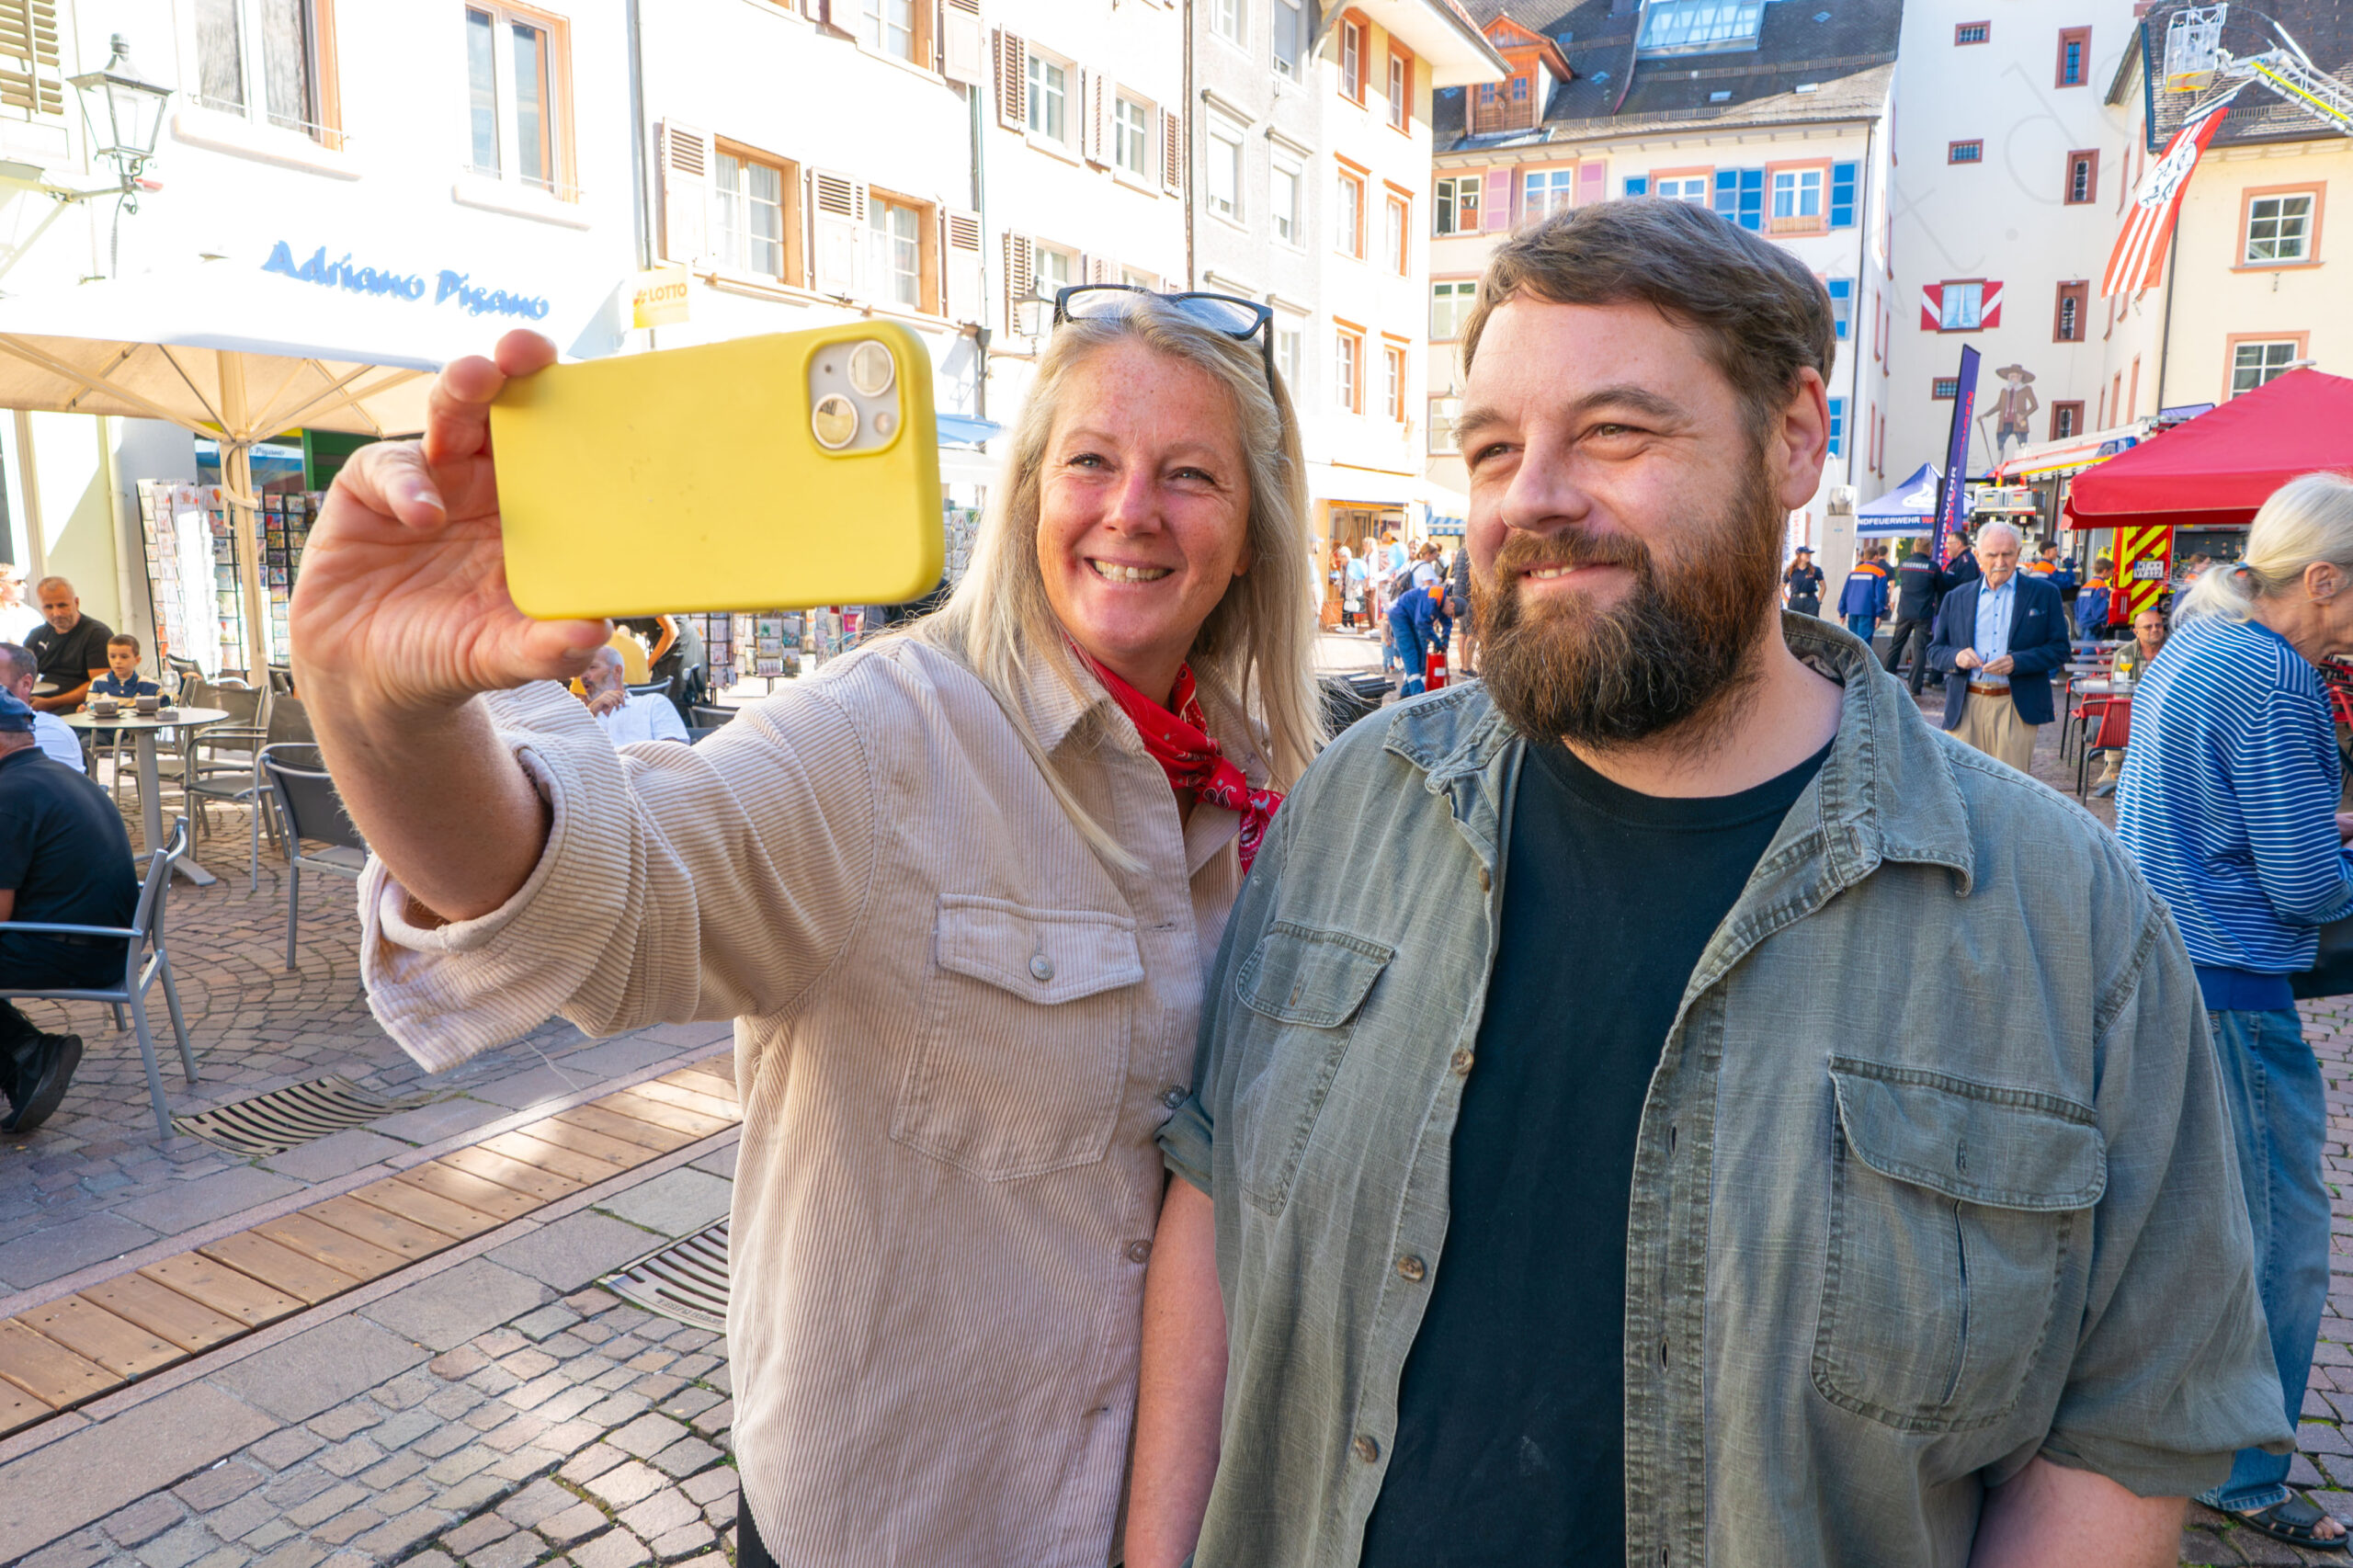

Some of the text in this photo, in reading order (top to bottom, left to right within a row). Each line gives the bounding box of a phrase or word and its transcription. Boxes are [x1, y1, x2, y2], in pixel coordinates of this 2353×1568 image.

[261, 240, 426, 302] Adriano
[649, 282, 688, 301] LOTTO
[2147, 569, 2161, 577] 112
